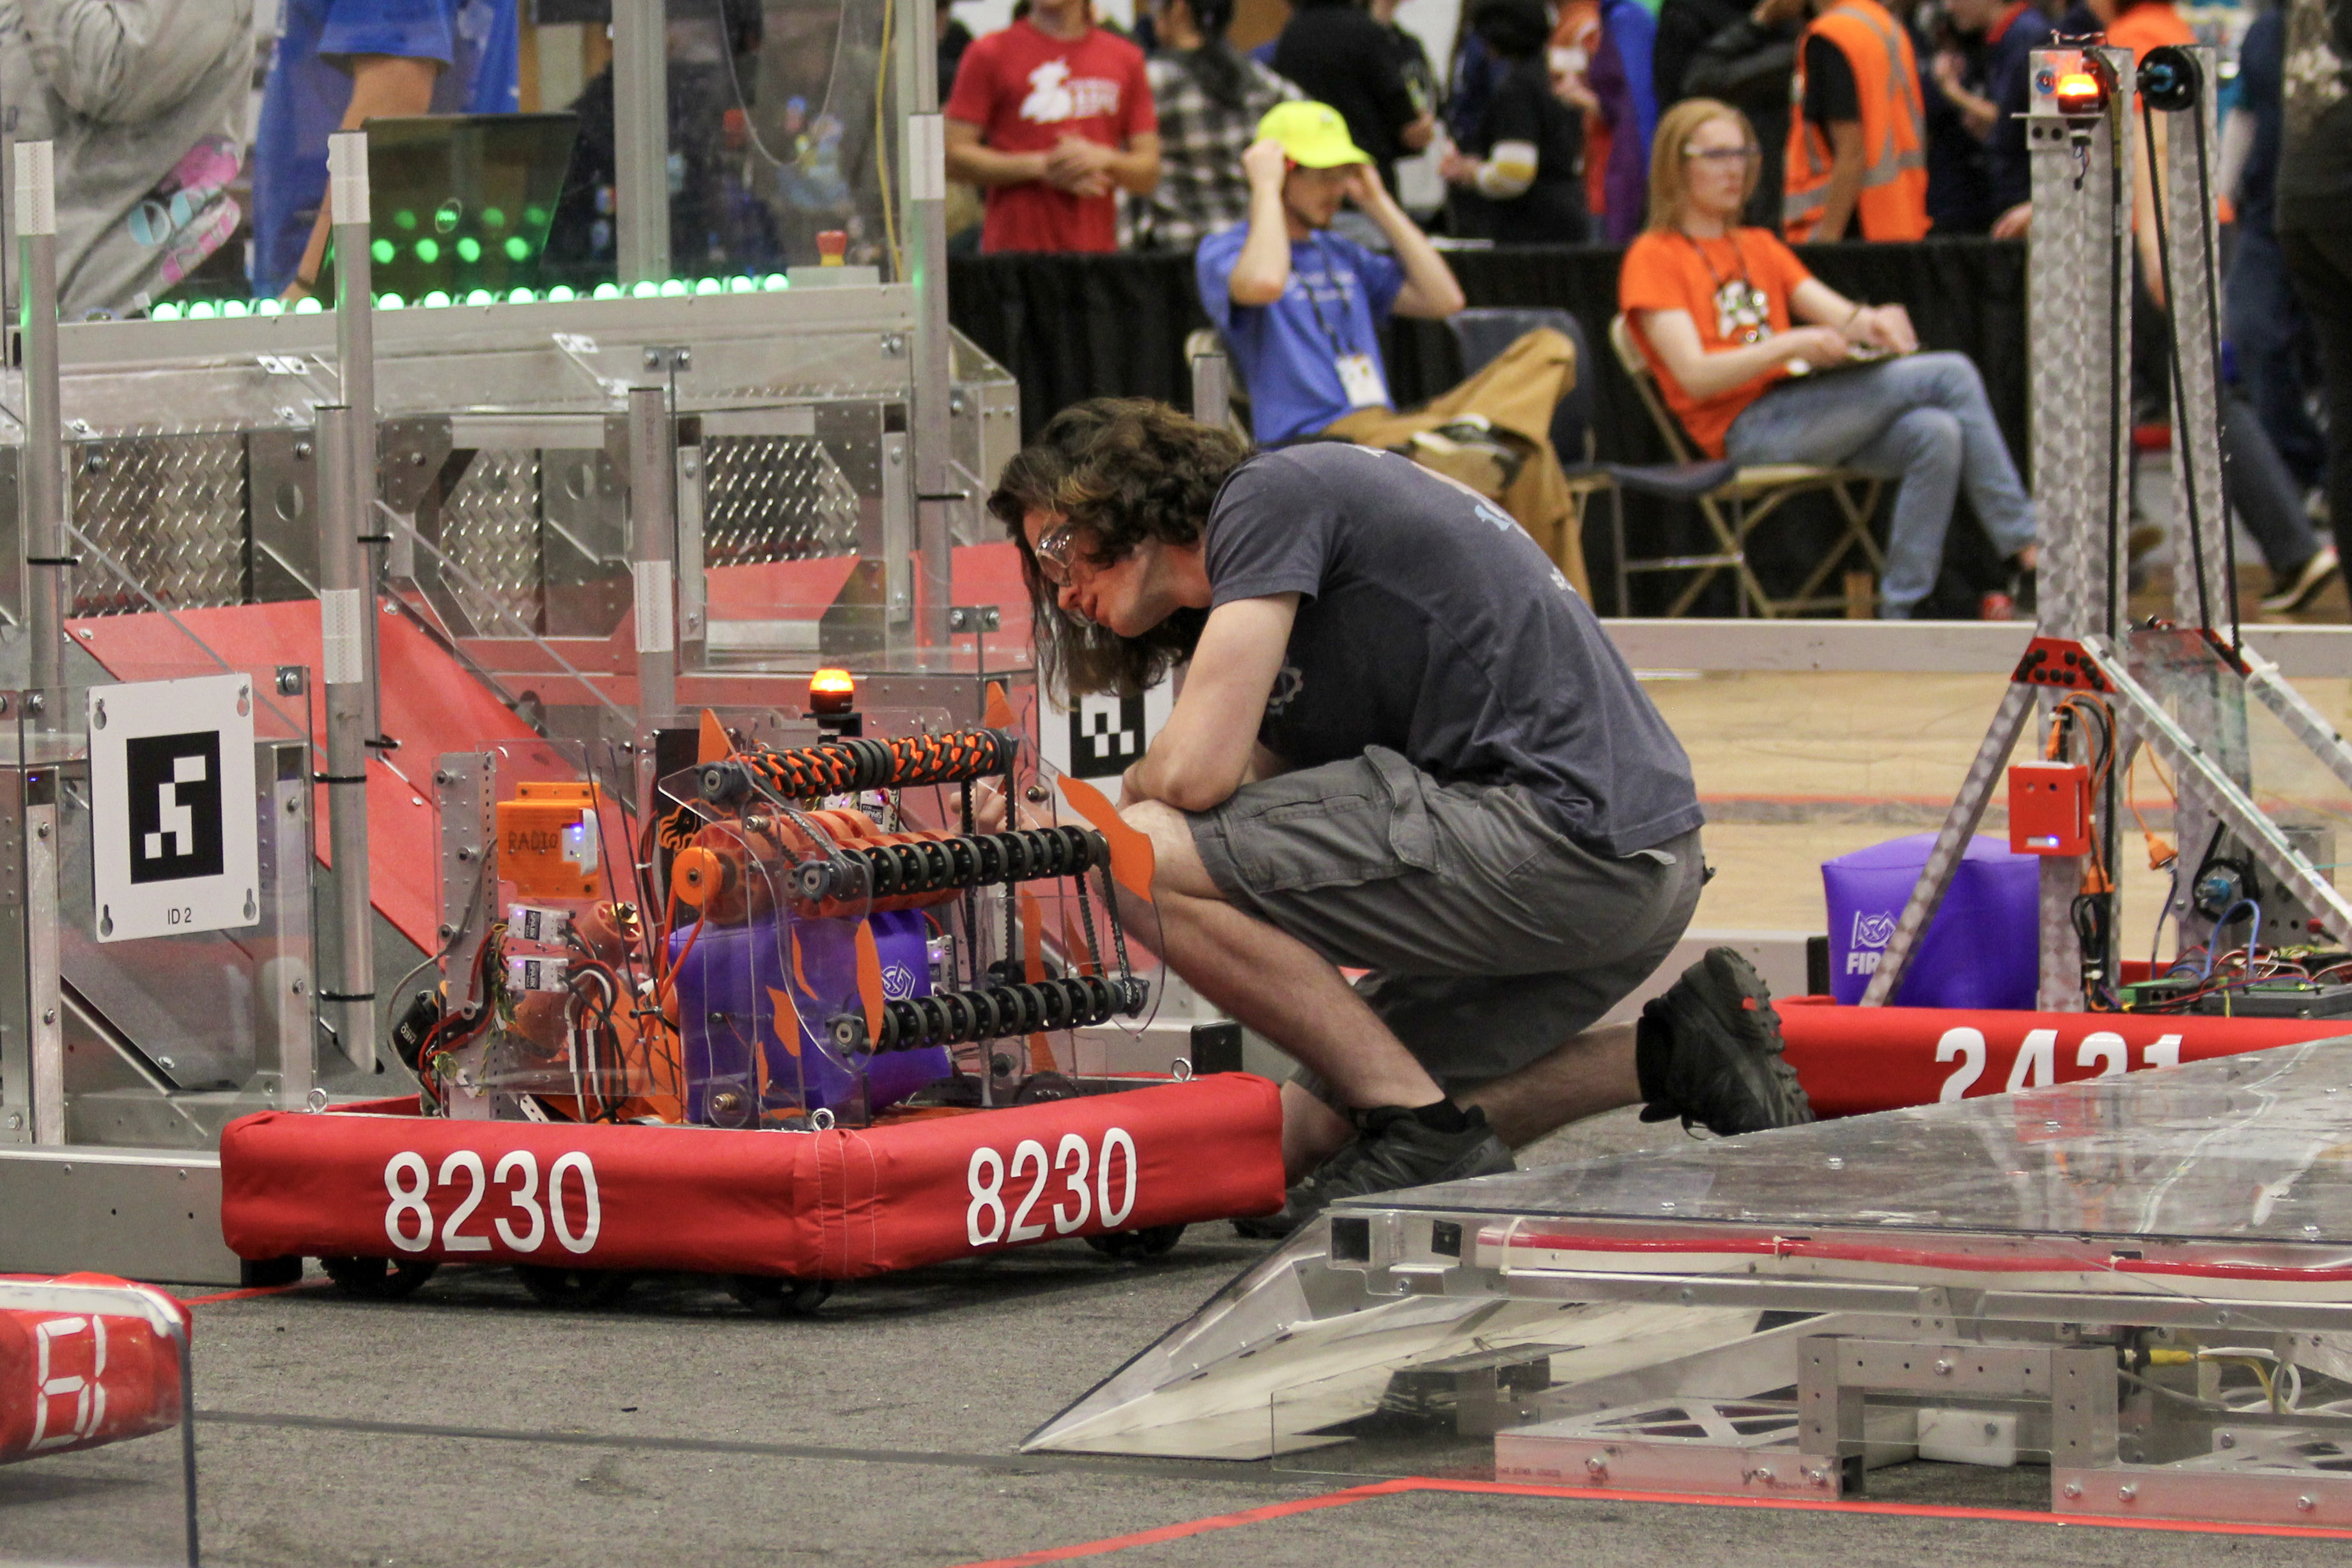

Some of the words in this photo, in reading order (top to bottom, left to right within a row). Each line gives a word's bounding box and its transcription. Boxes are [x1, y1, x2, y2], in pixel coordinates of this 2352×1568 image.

[507, 830, 558, 850] RADIO
[167, 909, 180, 925] ID
[184, 907, 192, 923] 2
[1846, 952, 1884, 975] FIR
[384, 1150, 601, 1254] 8230
[966, 1127, 1138, 1247] 8230
[26, 1314, 107, 1452] 61
